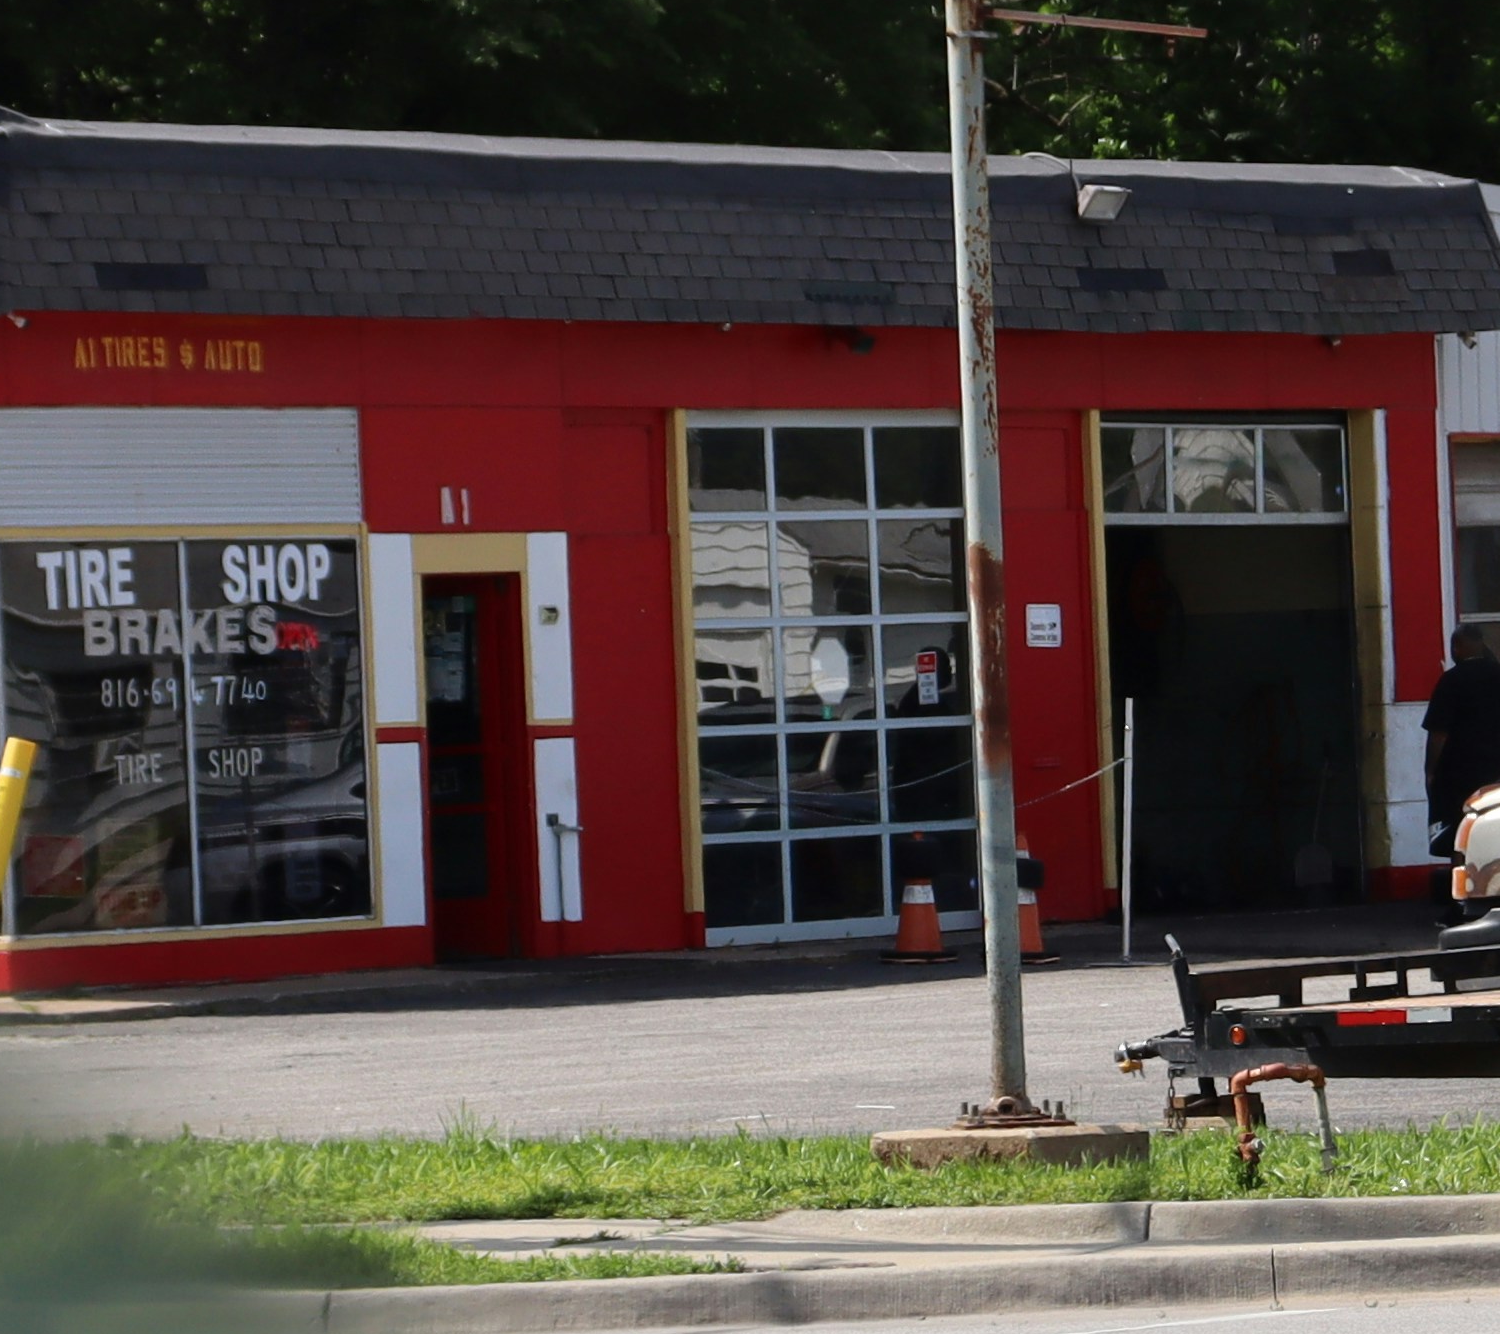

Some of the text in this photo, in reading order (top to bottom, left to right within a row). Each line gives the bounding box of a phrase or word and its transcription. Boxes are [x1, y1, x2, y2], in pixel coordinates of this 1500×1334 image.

[100, 335, 168, 369] TIRES
[204, 338, 264, 373] AUTO
[36, 543, 331, 611] TIRE SHOP
[82, 604, 280, 658] BRAKES
[113, 746, 264, 785] TIRE SHOP
